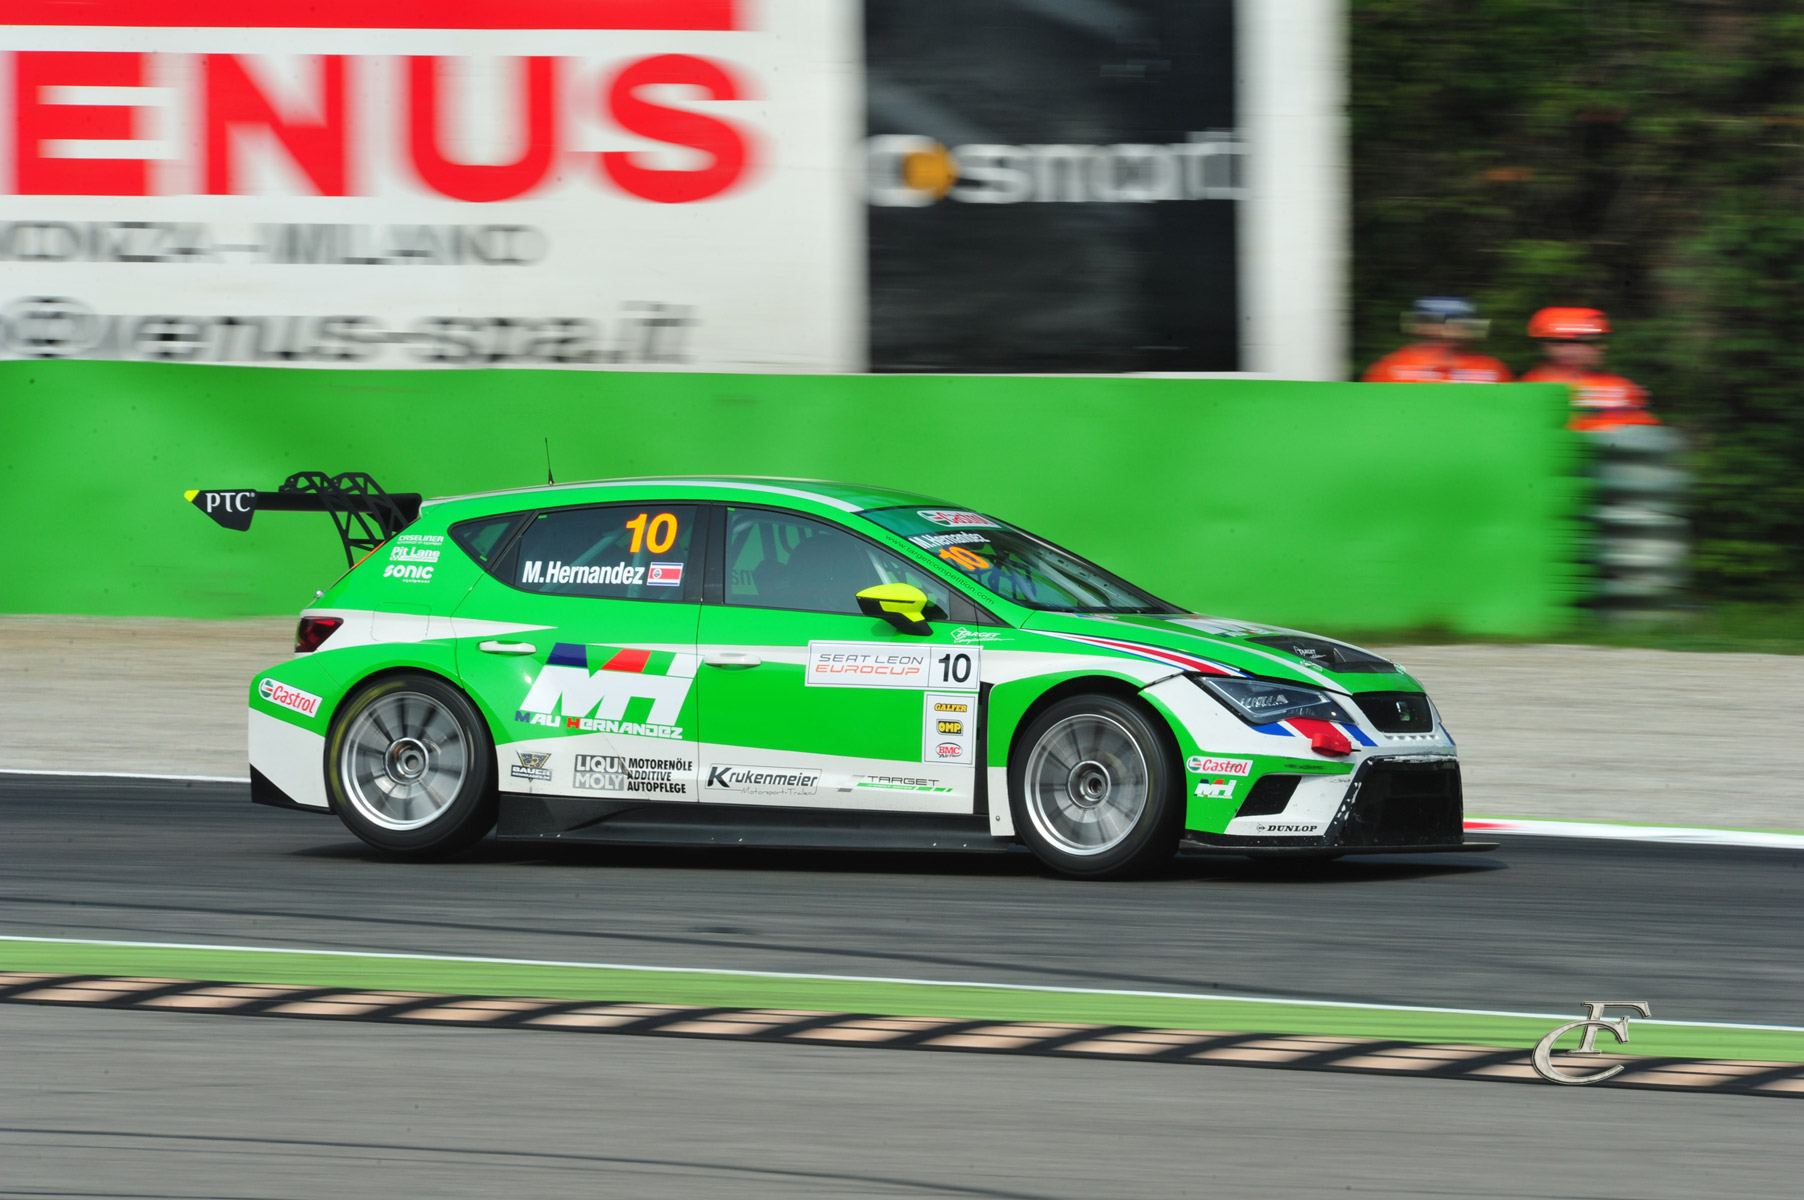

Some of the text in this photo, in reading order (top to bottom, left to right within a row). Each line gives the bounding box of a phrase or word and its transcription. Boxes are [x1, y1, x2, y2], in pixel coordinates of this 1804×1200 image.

[626, 512, 678, 554] 10
[938, 546, 990, 571] 10
[522, 560, 645, 585] M.Hernandez
[818, 653, 924, 665] SEAT LEON
[815, 664, 920, 676] EUROCUP
[938, 653, 972, 683] 10
[272, 685, 317, 714] Castrol
[934, 703, 968, 712] GALFER
[938, 721, 962, 733] OMP
[938, 746, 961, 755] BMC
[628, 757, 693, 772] MOTORENÖLE
[1202, 759, 1248, 775] Castrol
[574, 772, 624, 790] MOLY
[626, 770, 672, 782] ADDITIVE
[707, 766, 818, 788] Krukenmeier
[867, 775, 940, 787] TARGET
[626, 781, 687, 794] AUTOPFLEGE
[1266, 825, 1318, 833] DUNLOP
